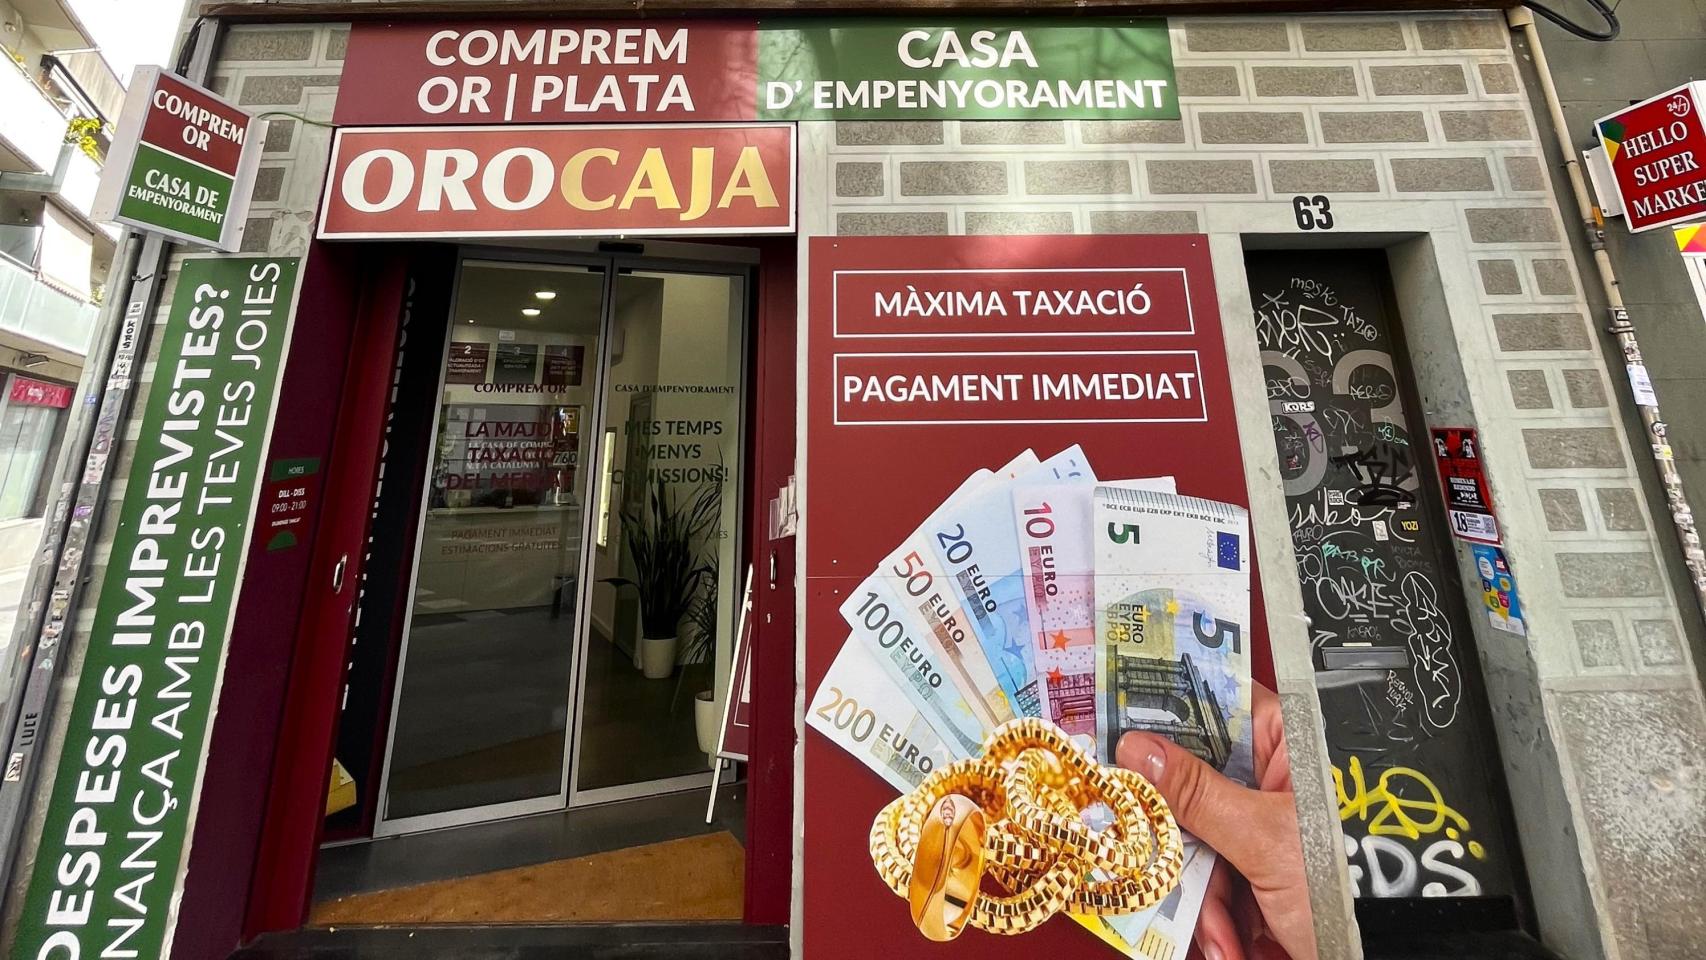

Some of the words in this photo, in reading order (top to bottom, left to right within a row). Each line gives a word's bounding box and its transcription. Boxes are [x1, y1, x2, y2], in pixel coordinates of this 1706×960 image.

[425, 28, 689, 67] COMPREM
[897, 30, 1039, 69] CASA
[417, 76, 492, 114] OR
[531, 74, 695, 113] PLATA
[813, 79, 1168, 109] EMPENYORAMENT
[153, 88, 246, 145] COMPREM
[182, 125, 210, 152] OR
[1622, 121, 1688, 159] HELLO
[144, 168, 192, 201] CASA
[194, 185, 219, 209] DE
[341, 146, 779, 222] OROCAJA
[1634, 151, 1699, 187] SUPER
[128, 185, 224, 225] EMPENYORAMENT
[1292, 195, 1334, 230] 63
[1632, 179, 1706, 218] MARKE
[231, 262, 281, 371] JOIES
[873, 285, 1007, 317] MÀXIMA
[1012, 283, 1151, 316] TAXACIÓ
[474, 383, 543, 394] COMPREM
[548, 383, 567, 394] OR
[615, 384, 640, 392] CASA
[843, 373, 1023, 403] PAGAMENT
[1033, 371, 1195, 401] IMMEDIAT
[198, 381, 255, 515] TEVES
[465, 421, 489, 438] LA
[666, 421, 723, 437] TEMPS
[111, 283, 230, 646] IMPREVISTES?
[510, 527, 556, 537] IMMEDIAT
[1024, 502, 1054, 538] 10
[1108, 521, 1140, 545] 5
[1400, 520, 1420, 531] YOZI
[1454, 512, 1468, 532] 18
[937, 523, 973, 564] 20
[178, 525, 226, 603] LES
[893, 551, 933, 597] 50
[1041, 545, 1058, 597] EURO
[967, 564, 997, 613] EURO
[856, 591, 904, 649] 100
[929, 593, 965, 643] EURO
[1132, 604, 1144, 644] EURO
[1192, 611, 1241, 655] 5
[151, 621, 205, 740] AMB
[900, 637, 942, 688] EURO
[816, 686, 876, 743] 200
[879, 723, 933, 774] EURO
